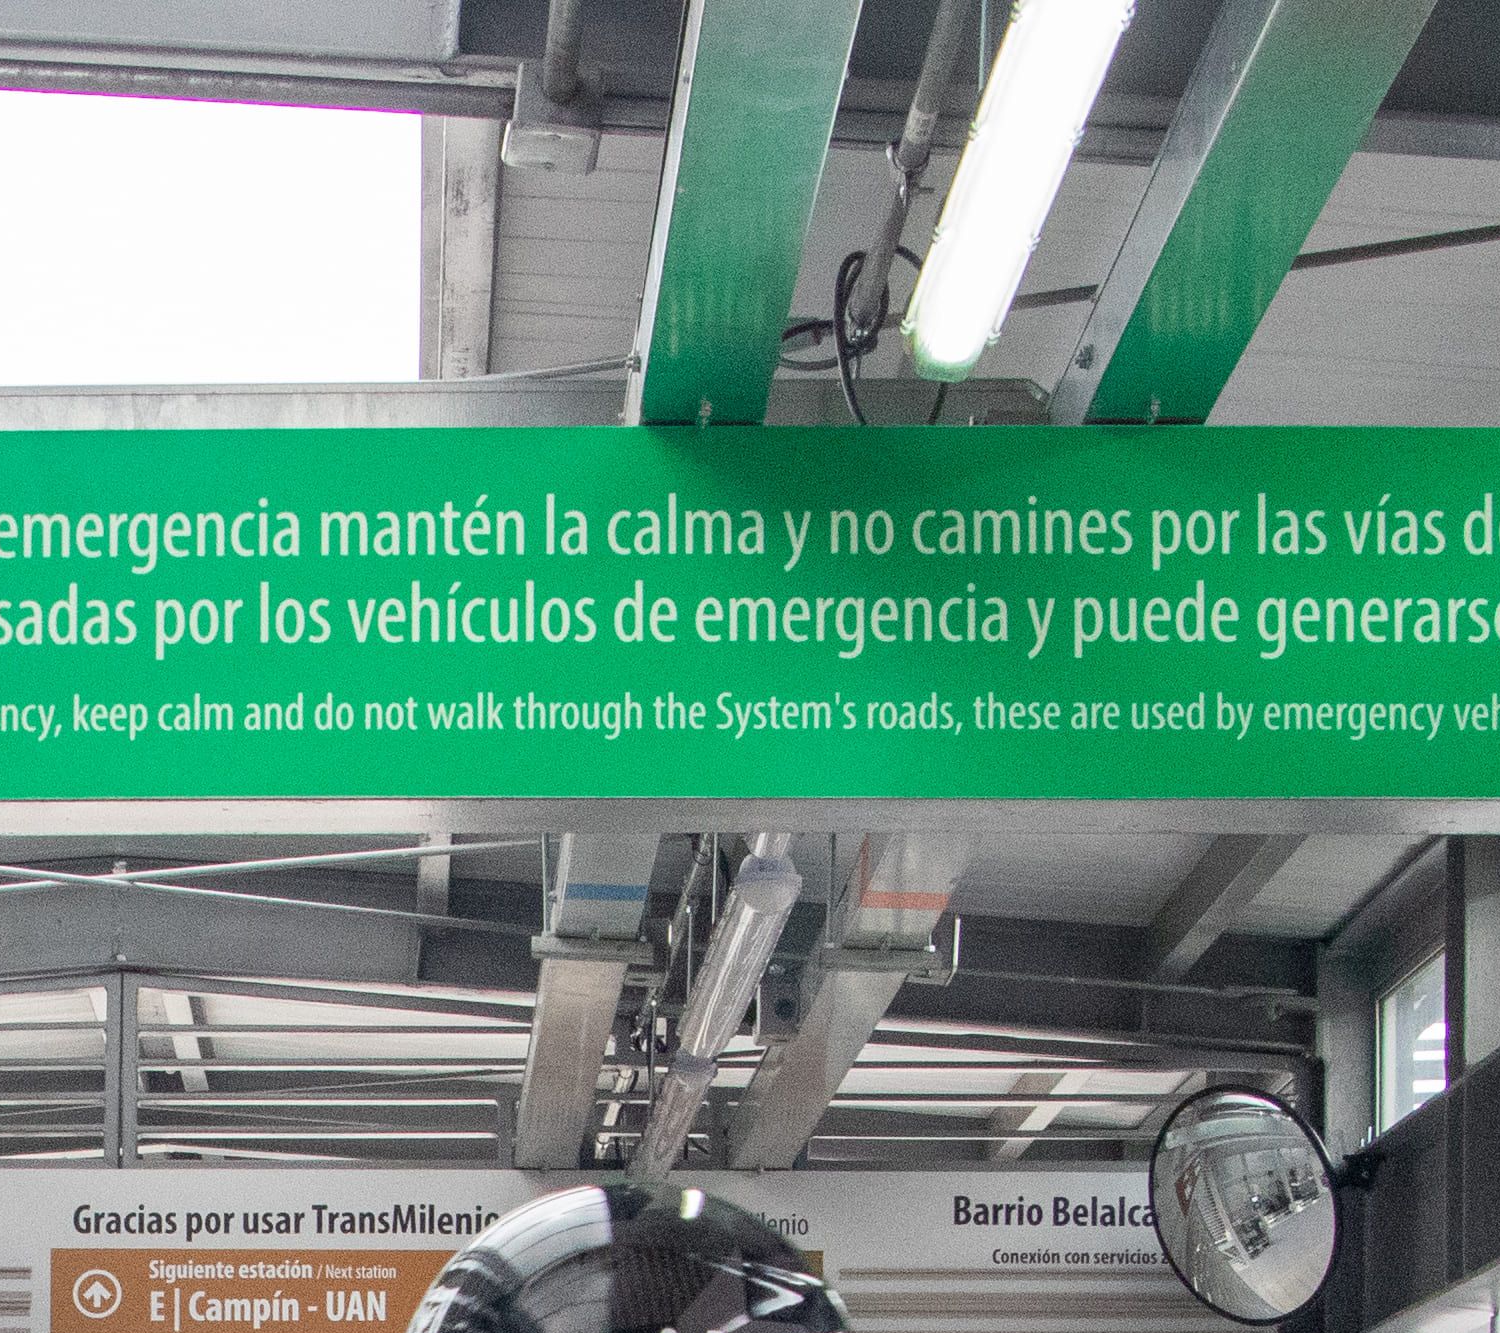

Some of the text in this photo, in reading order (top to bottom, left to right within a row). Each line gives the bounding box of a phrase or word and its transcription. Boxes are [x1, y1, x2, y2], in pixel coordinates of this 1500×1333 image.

[320, 493, 525, 557] mantén
[545, 492, 588, 556] la
[607, 492, 765, 555] calma
[784, 511, 811, 571] y
[830, 510, 894, 555] no
[912, 495, 1133, 555] camines
[1152, 509, 1240, 571] por
[1257, 492, 1327, 555] las
[1344, 493, 1446, 555] vías
[155, 598, 244, 661] por
[259, 581, 332, 644] los
[347, 579, 597, 643] vehículos
[613, 579, 678, 643] de
[695, 583, 1008, 659] emergencia
[1027, 597, 1055, 659] y
[1074, 579, 1239, 658] puede
[72, 693, 149, 741] keep
[157, 692, 234, 732] calm
[243, 692, 304, 731] and
[313, 692, 355, 731] do
[364, 696, 418, 731] not
[426, 691, 504, 731] walk
[513, 691, 643, 741] through
[653, 691, 707, 730] the
[716, 691, 857, 740] System's
[867, 692, 962, 734] roads,
[973, 691, 1061, 730] these
[1070, 702, 1120, 730] are
[1131, 692, 1205, 730] used
[1216, 692, 1254, 740] by
[1263, 702, 1444, 741] emergency
[73, 1204, 177, 1235] Gracias
[186, 1212, 235, 1243] por
[242, 1212, 306, 1235] usar
[953, 1195, 1154, 1228] Barrio Belalca
[148, 1259, 235, 1285] Siguiente
[238, 1259, 313, 1279] estación
[325, 1264, 353, 1279] Next
[355, 1263, 398, 1279] station
[992, 1249, 1060, 1264] Conexión
[1064, 1252, 1090, 1264] con
[1094, 1248, 1158, 1265] servicios
[150, 1290, 165, 1322] E
[188, 1290, 300, 1330] Campín
[326, 1290, 387, 1322] UAN
